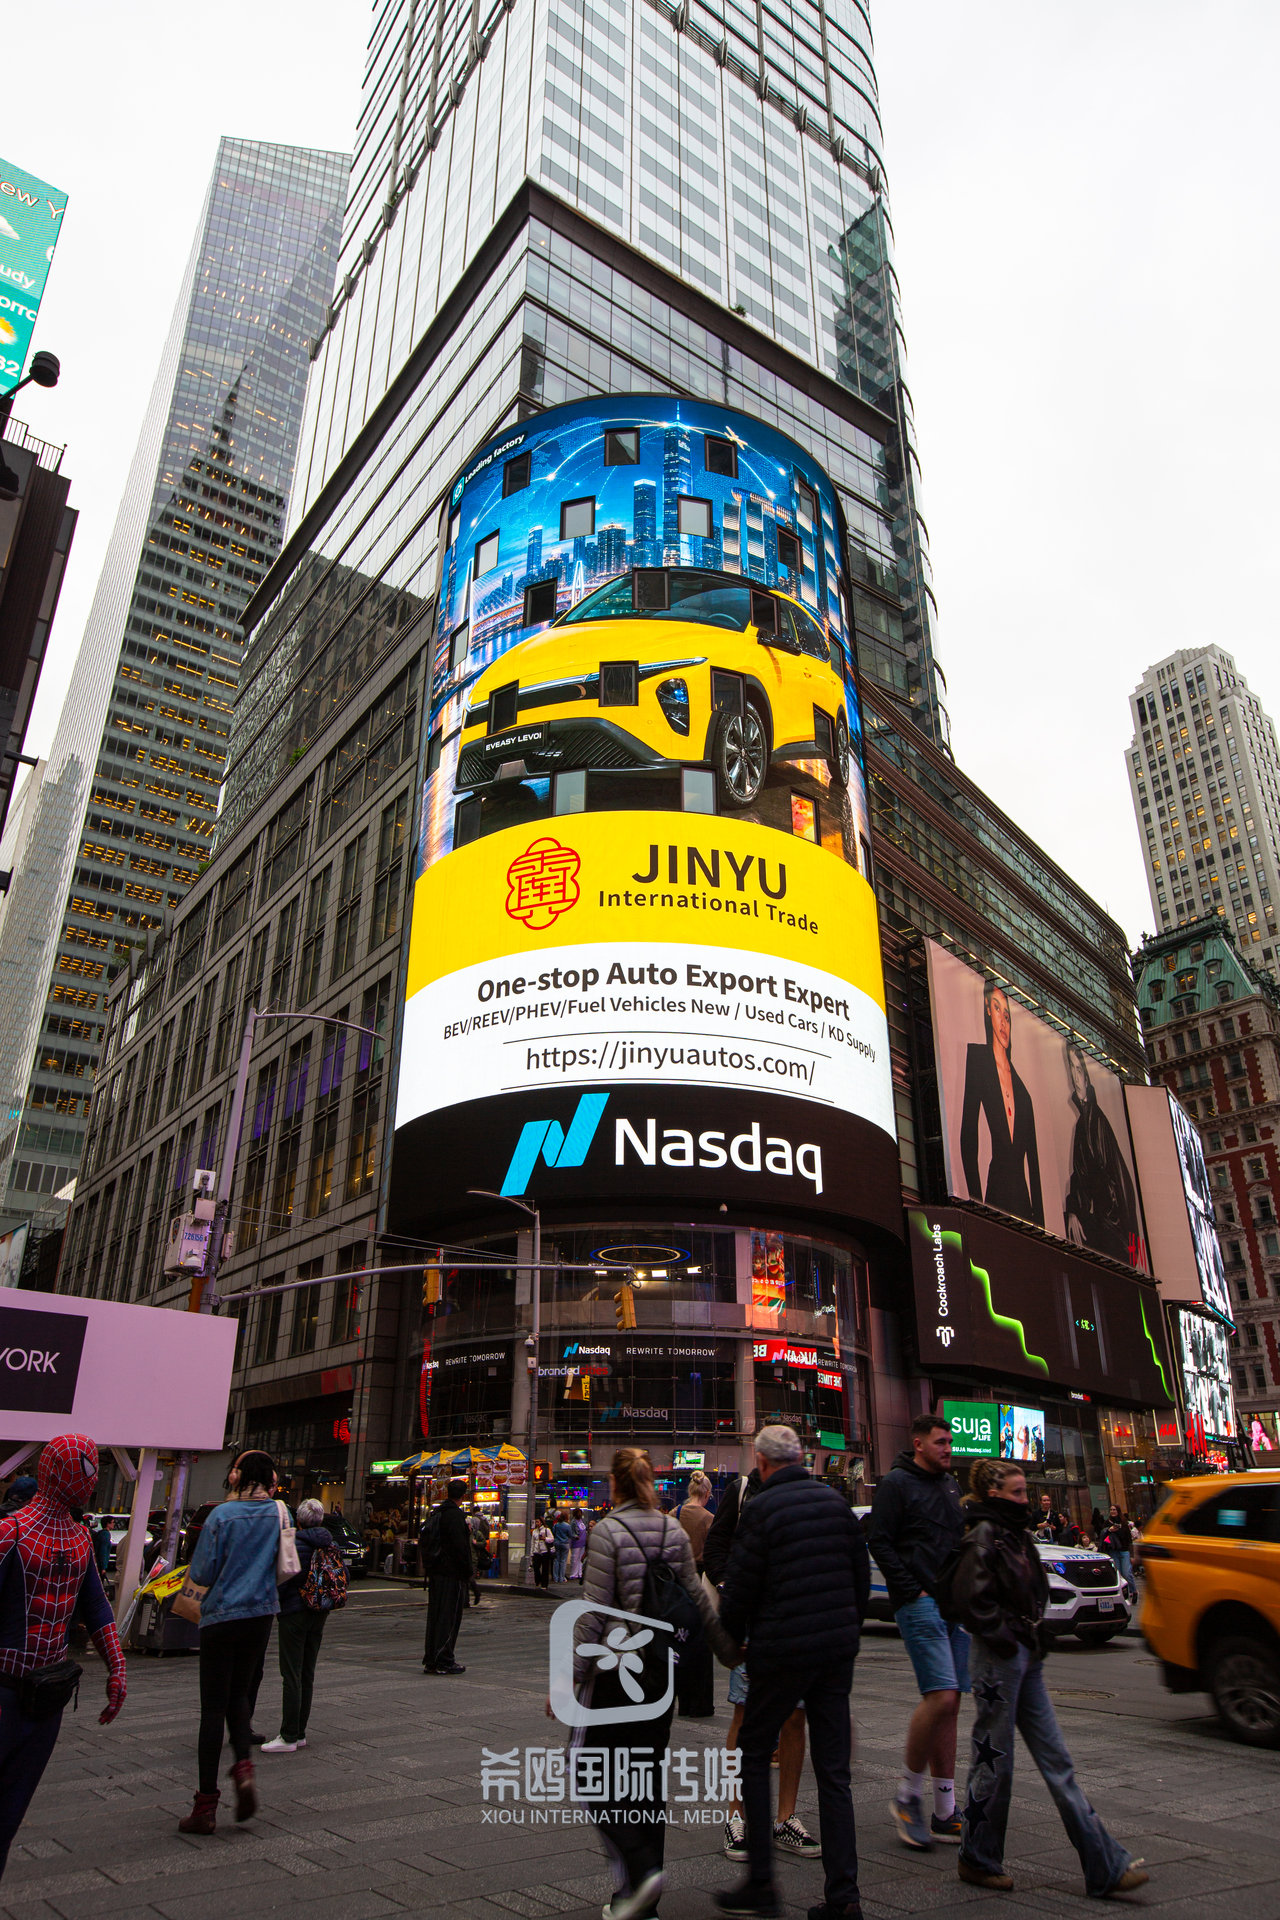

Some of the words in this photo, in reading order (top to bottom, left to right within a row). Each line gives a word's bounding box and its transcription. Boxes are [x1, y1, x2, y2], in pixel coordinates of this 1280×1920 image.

[0, 176, 40, 208] ew
[493, 434, 525, 458] factory
[485, 735, 517, 751] EVEASY
[632, 844, 788, 900] JINYU
[599, 890, 759, 918] International
[765, 904, 819, 935] Trade
[478, 967, 600, 1003] One-stop
[606, 962, 678, 986] Auto
[686, 964, 778, 998] Export
[784, 978, 850, 1021] Expert
[444, 996, 606, 1040] BEV/REEV/PHEV/Fuel
[610, 996, 686, 1012] Vehicles
[691, 999, 730, 1016] New
[745, 1005, 784, 1025] Used
[788, 1013, 818, 1034] Cars
[828, 1024, 844, 1042] KD
[846, 1032, 876, 1063] Supply
[527, 1040, 816, 1086] https://jinyuautos.com/
[615, 1118, 824, 1195] Nasdaq
[931, 1223, 943, 1252] Labs
[934, 1253, 949, 1317] Cockroach
[578, 1346, 611, 1356] Nasdaq
[626, 1347, 664, 1355] REWRITE
[668, 1347, 716, 1357] TOMORROW
[622, 1405, 669, 1421] Nasdaq
[951, 1417, 992, 1441] suja
